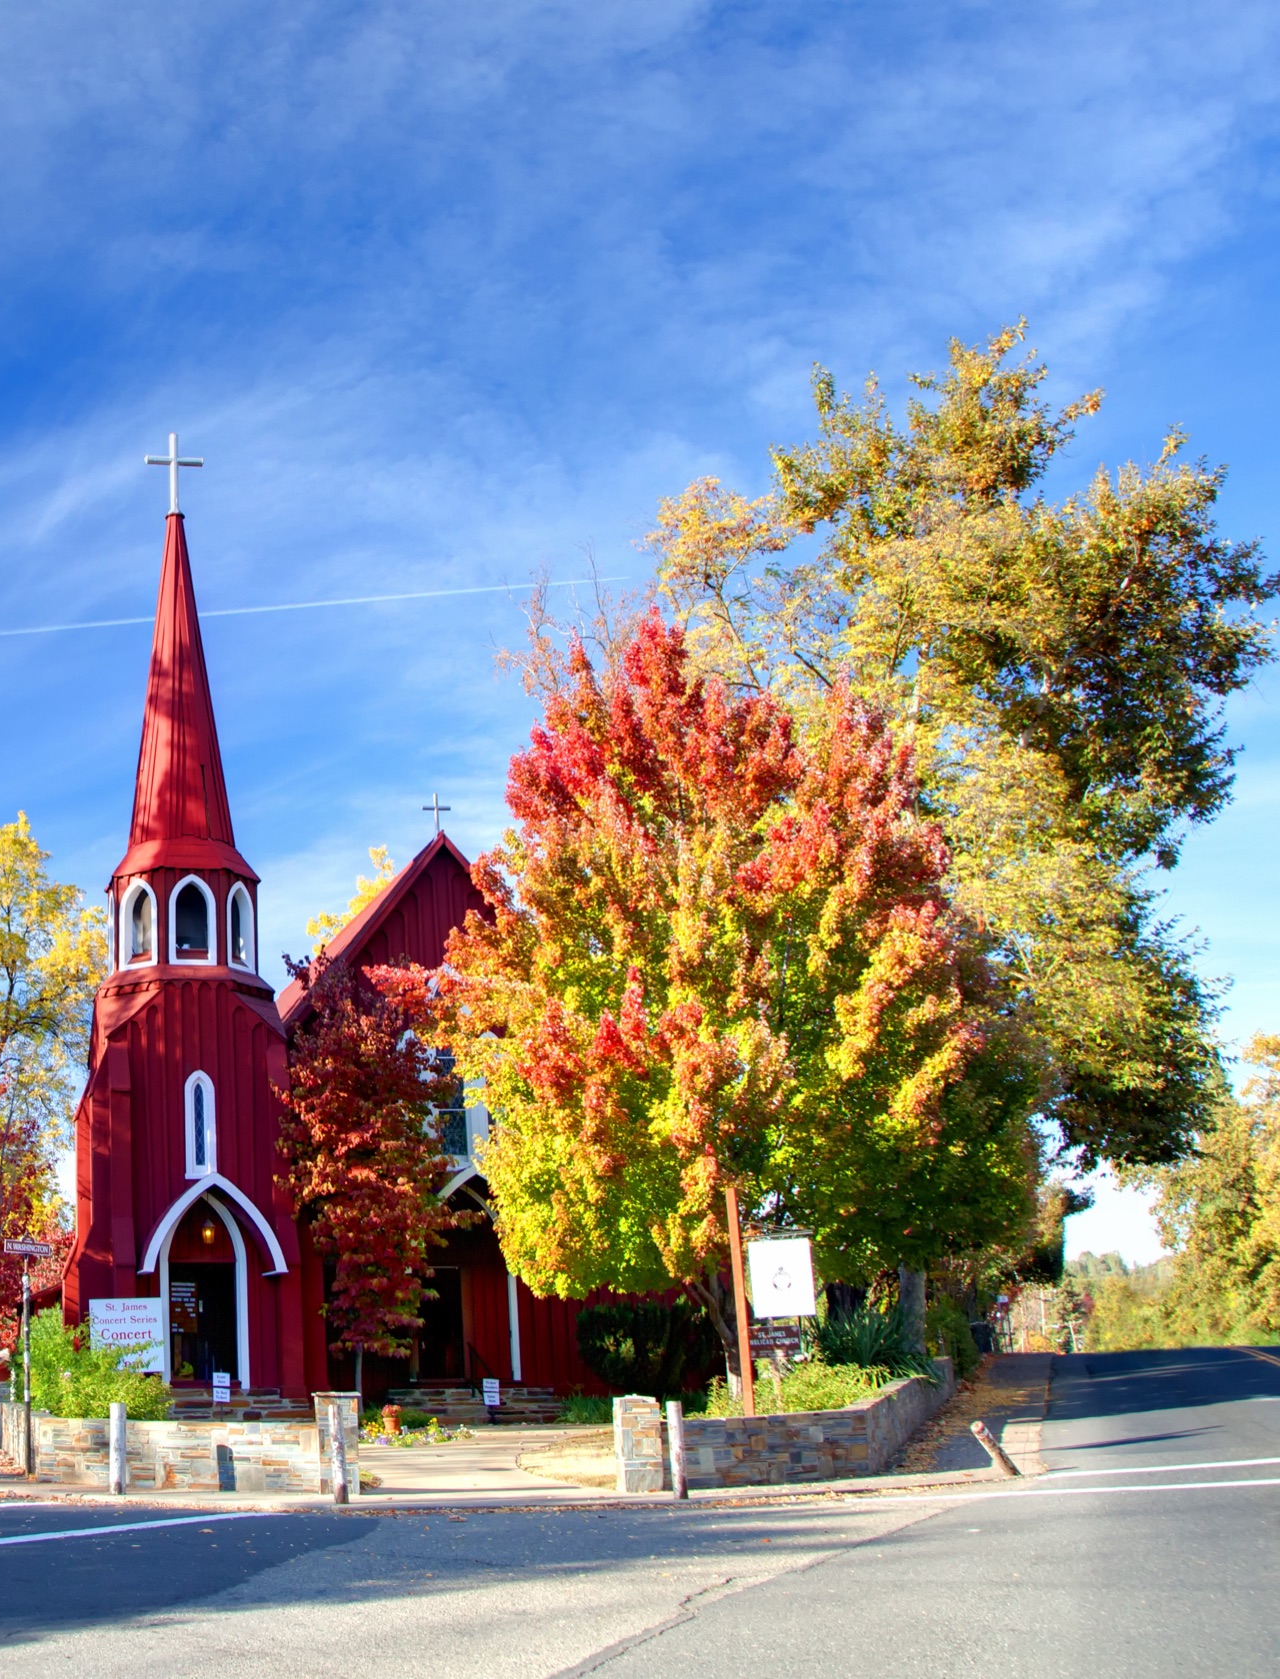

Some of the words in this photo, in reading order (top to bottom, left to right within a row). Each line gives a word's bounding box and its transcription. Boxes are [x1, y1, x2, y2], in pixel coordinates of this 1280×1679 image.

[13, 1243, 49, 1253] WASHINGTON
[105, 1303, 117, 1311] St.
[121, 1302, 148, 1312] James
[93, 1316, 126, 1325] Concert
[130, 1315, 158, 1324] Series
[101, 1328, 152, 1340] Concert
